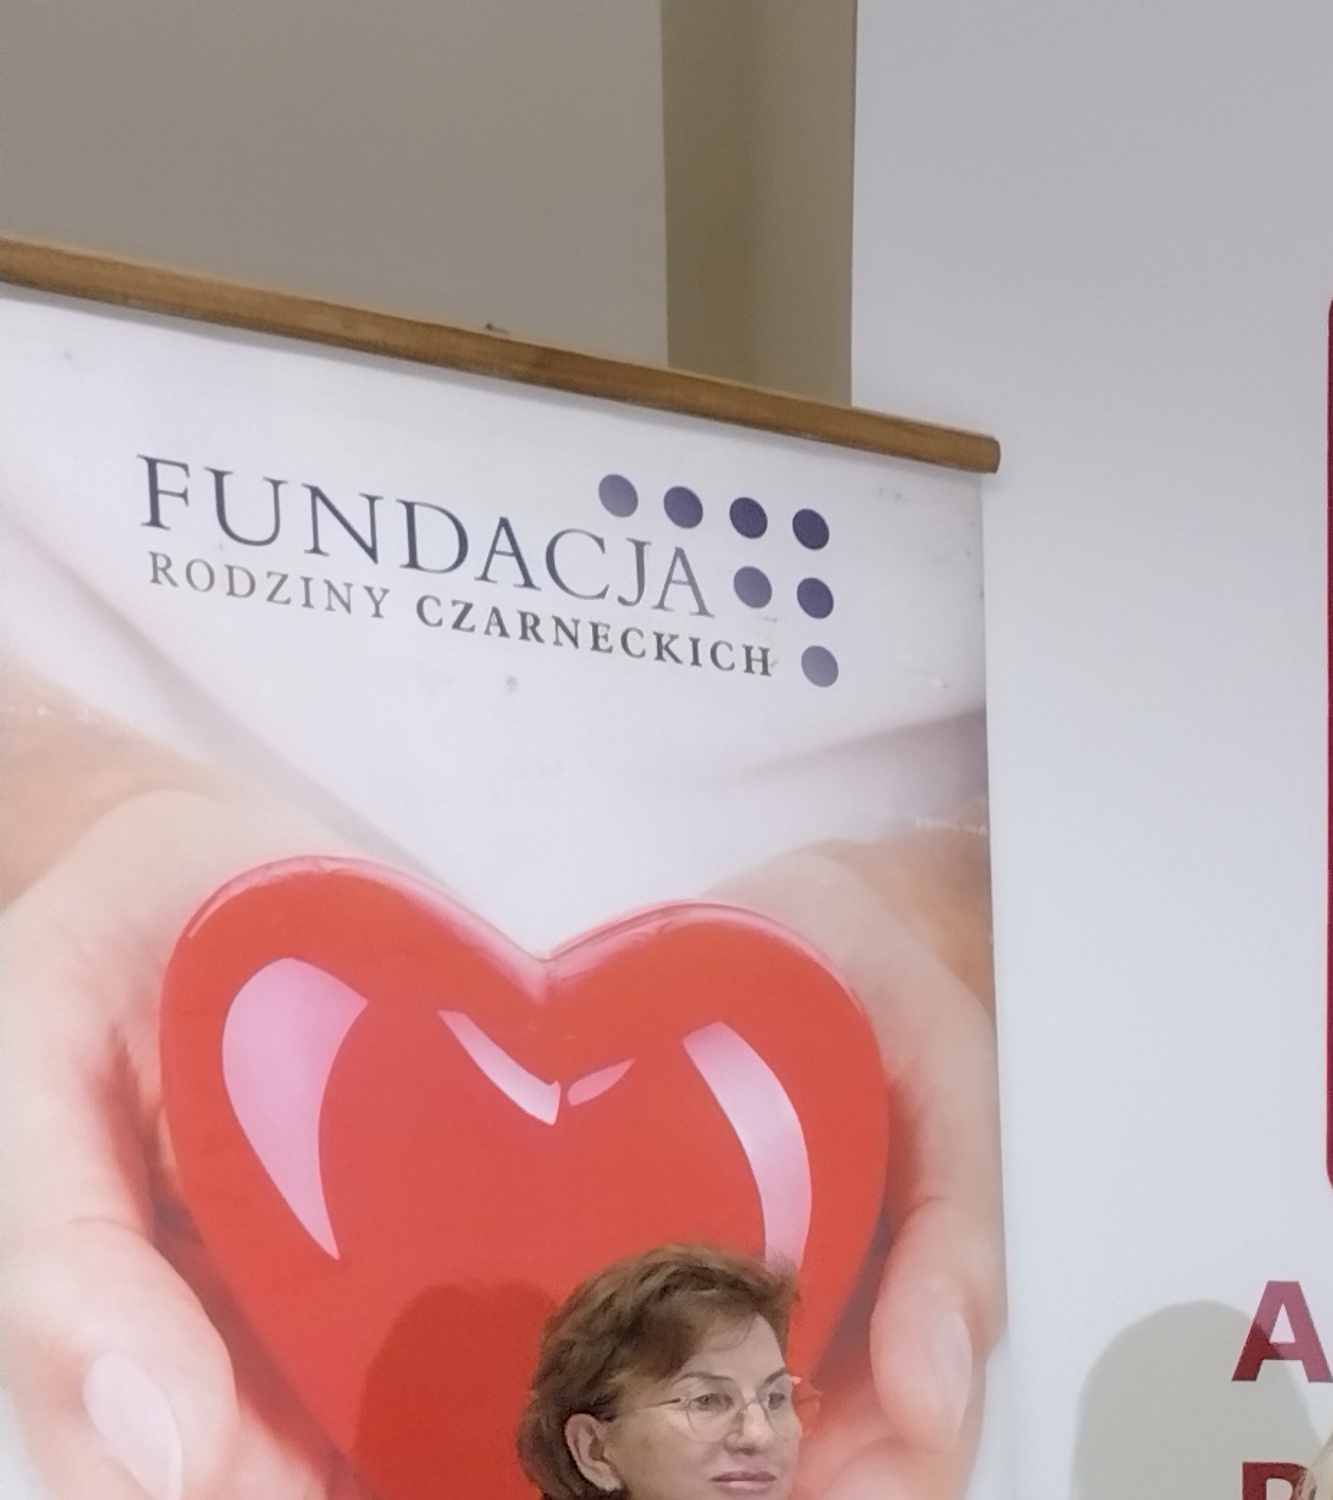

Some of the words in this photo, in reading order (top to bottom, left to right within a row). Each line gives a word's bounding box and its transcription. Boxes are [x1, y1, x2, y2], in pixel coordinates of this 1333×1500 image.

[137, 454, 714, 618] FUNDACJA
[148, 551, 389, 619] RODZINY
[416, 594, 774, 677] CZARNECKICH
